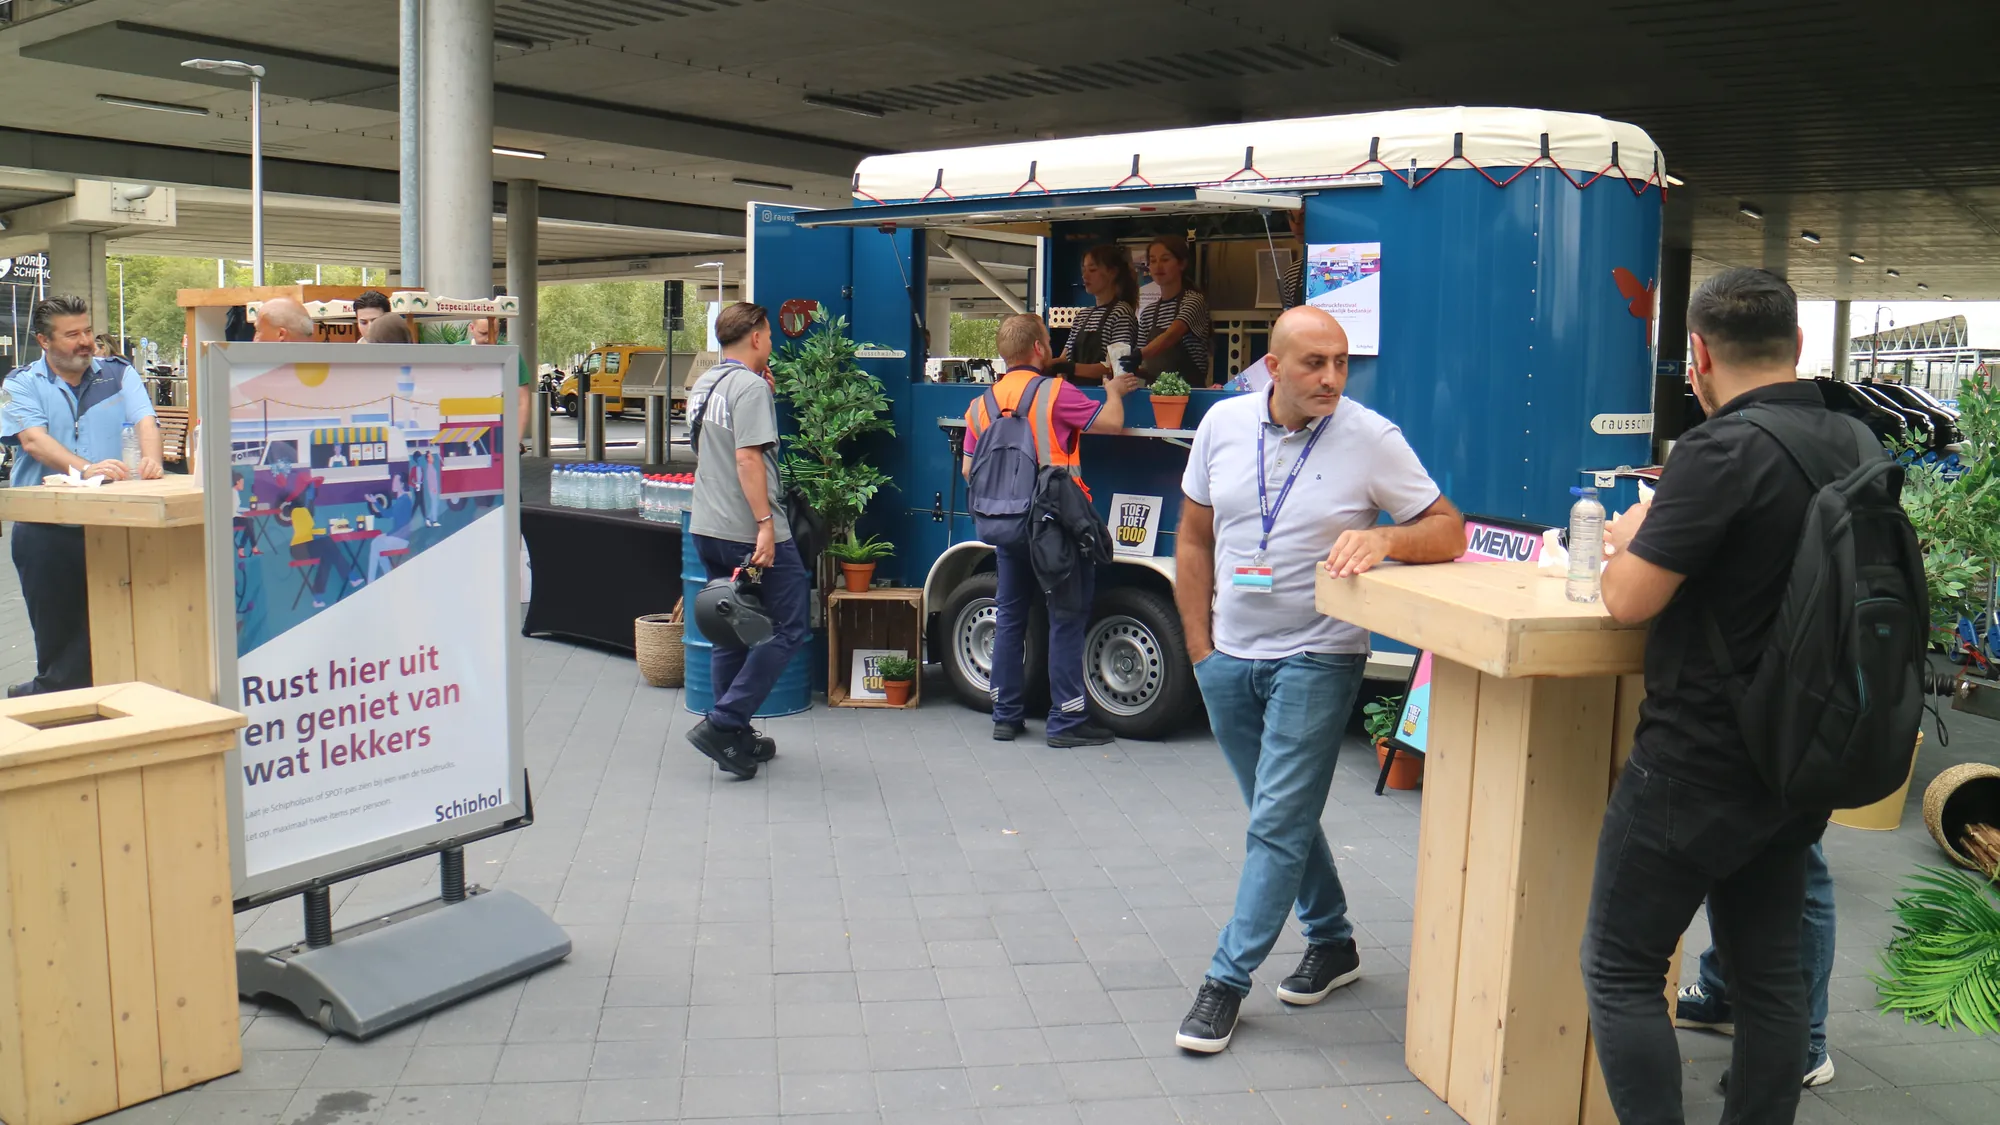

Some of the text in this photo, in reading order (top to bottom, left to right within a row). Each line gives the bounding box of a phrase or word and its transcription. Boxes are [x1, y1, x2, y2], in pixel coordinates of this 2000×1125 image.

[15, 255, 48, 267] WORLD
[1121, 504, 1151, 516] TOET
[1122, 516, 1145, 527] TOET
[1116, 526, 1146, 542] FOOD
[1468, 524, 1537, 562] MENU
[242, 644, 440, 707] Rust hier uit
[244, 682, 461, 747] en geniet van
[243, 723, 432, 787] wat lekkers
[245, 809, 261, 820] Laat
[271, 796, 315, 813] Schipholpas
[324, 785, 358, 799] SPOT-pas
[358, 782, 373, 791] zien
[373, 778, 383, 788] bij
[384, 776, 397, 785] een
[398, 772, 410, 781] van
[411, 768, 420, 778] de
[435, 788, 503, 823] Schiphol
[245, 832, 258, 842] Let
[272, 818, 308, 834] maximaal
[309, 813, 329, 825] twee
[329, 808, 349, 819] items
[349, 805, 361, 816] per
